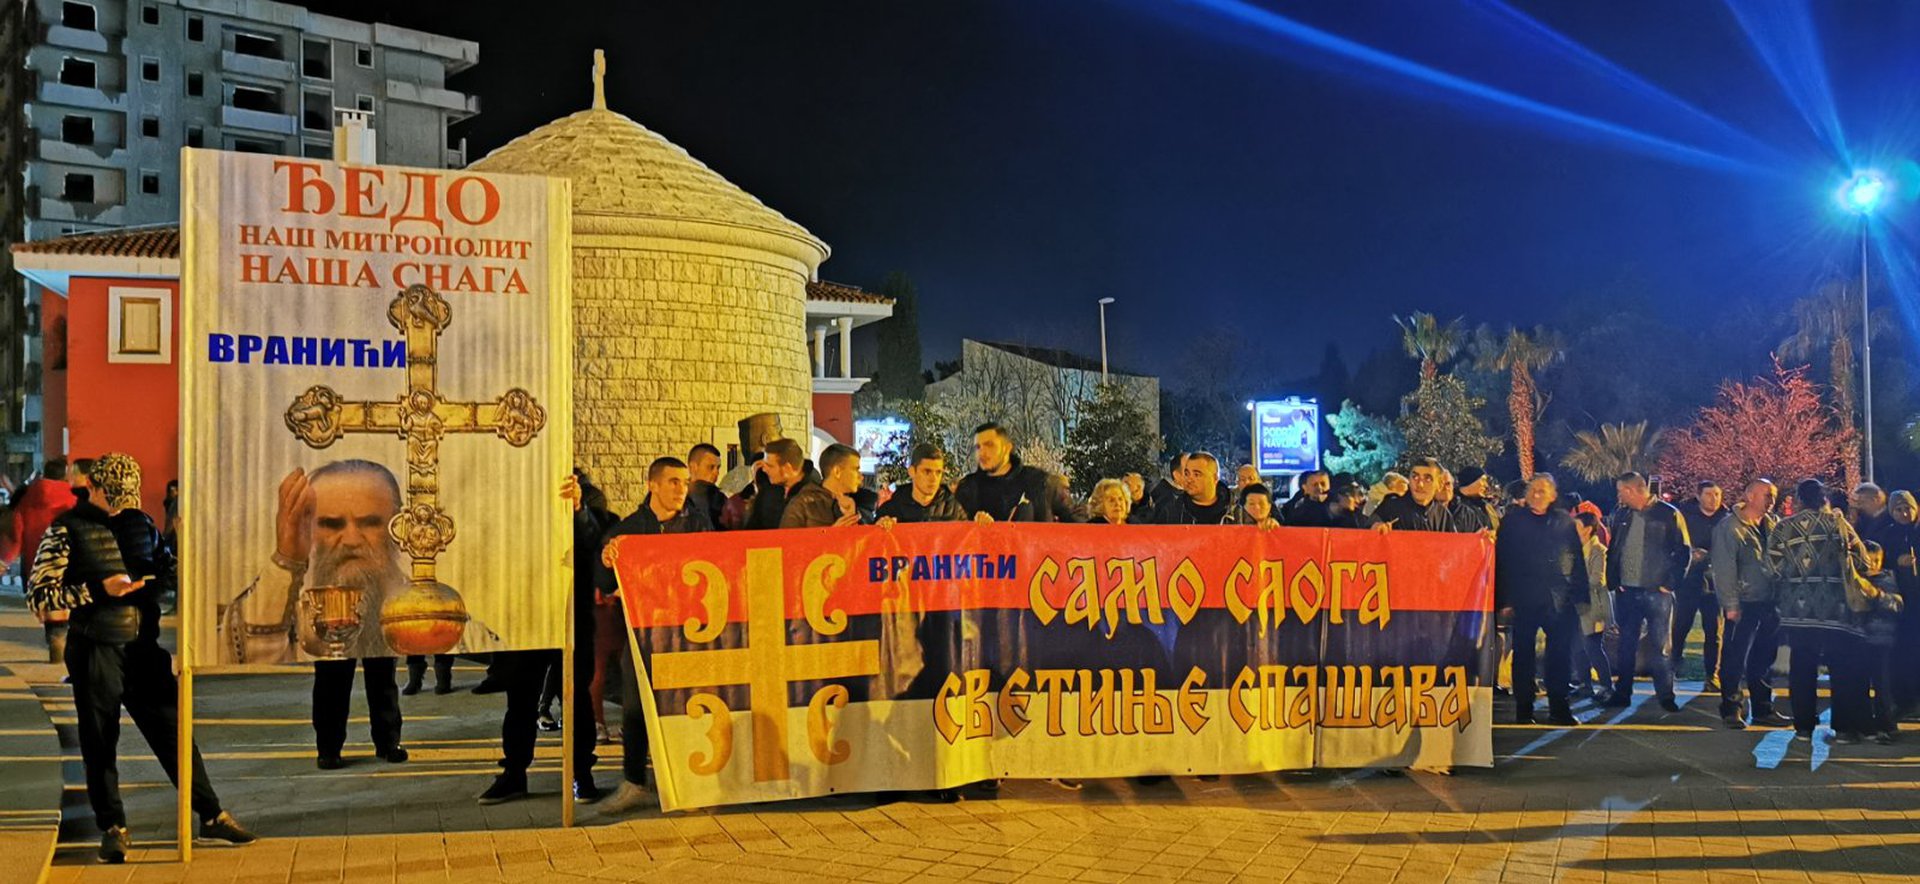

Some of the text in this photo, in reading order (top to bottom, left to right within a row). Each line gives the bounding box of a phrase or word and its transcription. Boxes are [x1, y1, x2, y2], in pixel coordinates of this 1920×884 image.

[273, 160, 501, 235] ЂЕДО
[239, 224, 532, 260] НАШ МИТРОПОЛИТ
[239, 254, 529, 294] НАША СНАГА
[208, 333, 406, 368] ВРАНИЋИ
[868, 554, 1017, 583] ВРАНИЋИ
[1028, 555, 1391, 639] САМО СЛОГА
[1228, 665, 1472, 735] СПАШАВА
